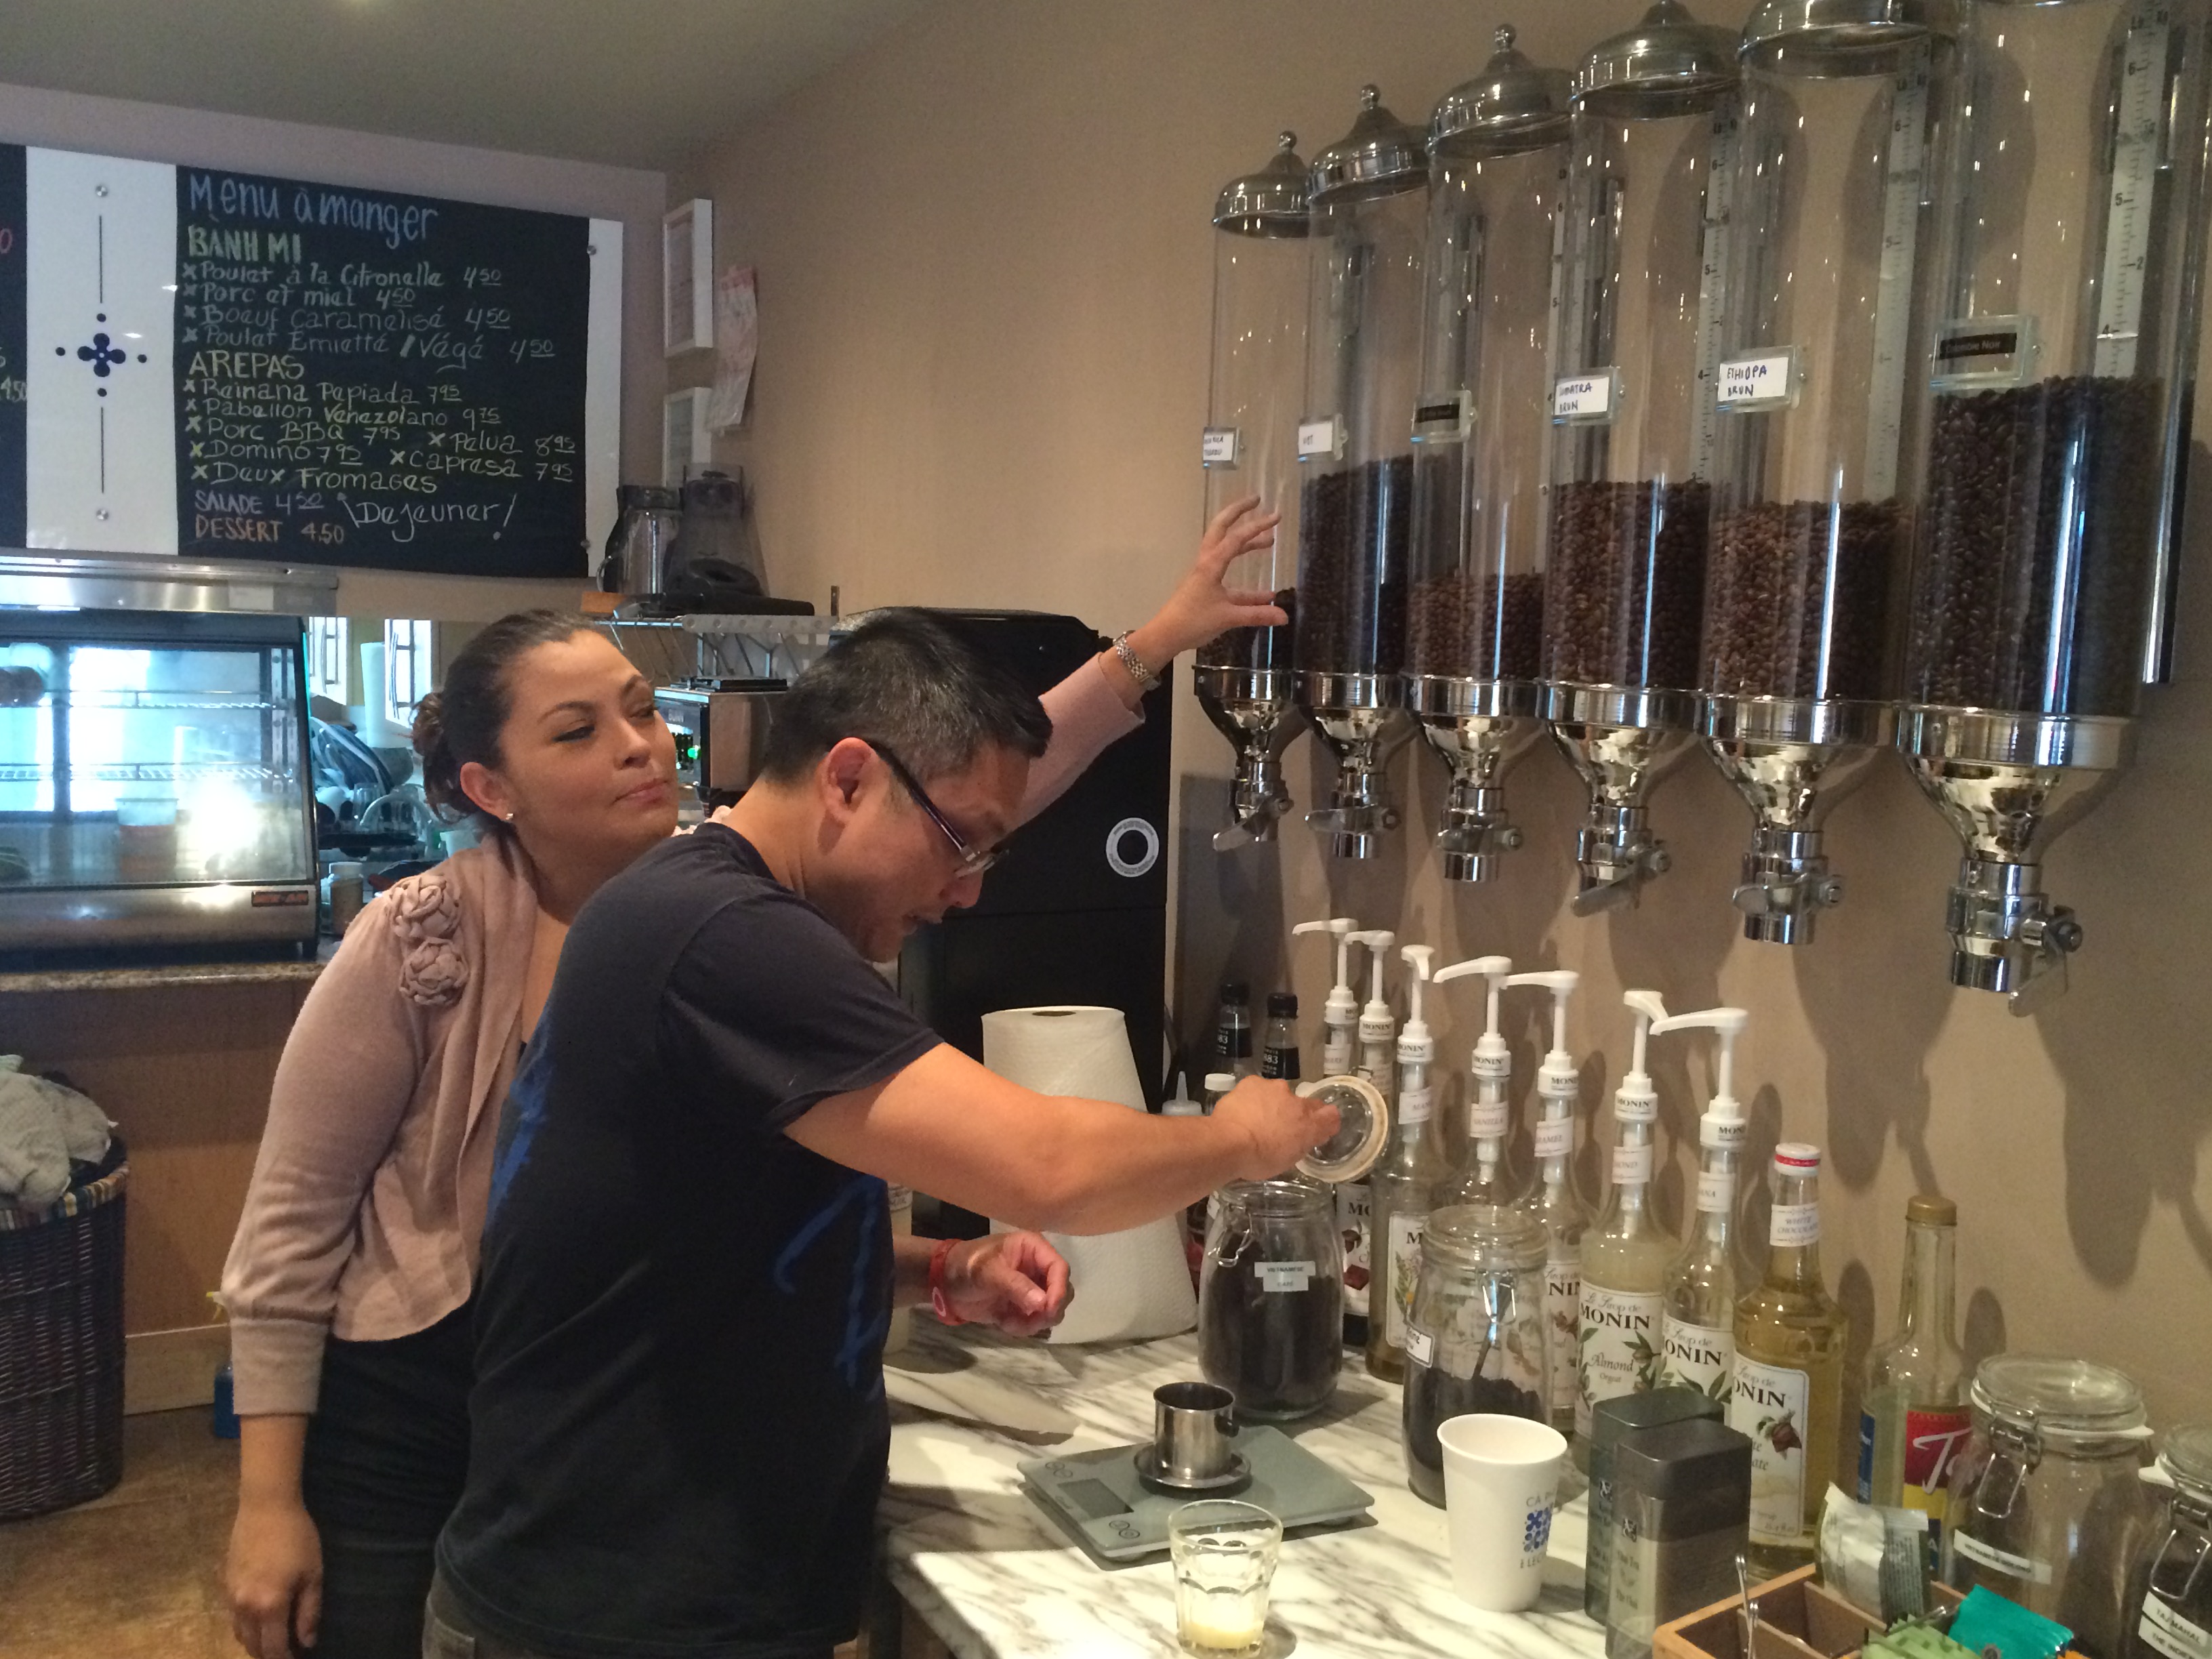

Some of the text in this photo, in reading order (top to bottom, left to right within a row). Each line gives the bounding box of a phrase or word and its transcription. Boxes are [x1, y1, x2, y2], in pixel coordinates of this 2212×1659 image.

[189, 173, 280, 220] Menu
[319, 192, 438, 249] manger
[268, 232, 301, 264] MI
[201, 260, 273, 283] Poulet
[201, 282, 255, 302] Porc
[266, 284, 294, 306] et
[304, 286, 356, 306] miel
[200, 304, 279, 331] Boeuf
[205, 325, 278, 346] Poulet
[189, 350, 304, 380] AREPAS
[316, 382, 419, 411] Pepiada
[323, 403, 447, 426] Venezolano
[207, 417, 265, 440] Porc
[276, 421, 344, 444] BBQ
[448, 430, 523, 454] Pelua
[203, 439, 310, 462] Domino
[211, 461, 285, 485] Deux
[194, 490, 263, 515] SALADE
[195, 514, 283, 541] DESSERT
[1363, 1023, 1390, 1031] MONIN
[1617, 1098, 1650, 1107] MONIN
[1580, 1302, 1651, 1330] MONIN
[1589, 1352, 1634, 1372] Almond
[1664, 1338, 1722, 1366] ONIN
[1732, 1376, 1786, 1408] ONIN
[2170, 1620, 2200, 1643] MAHAL
